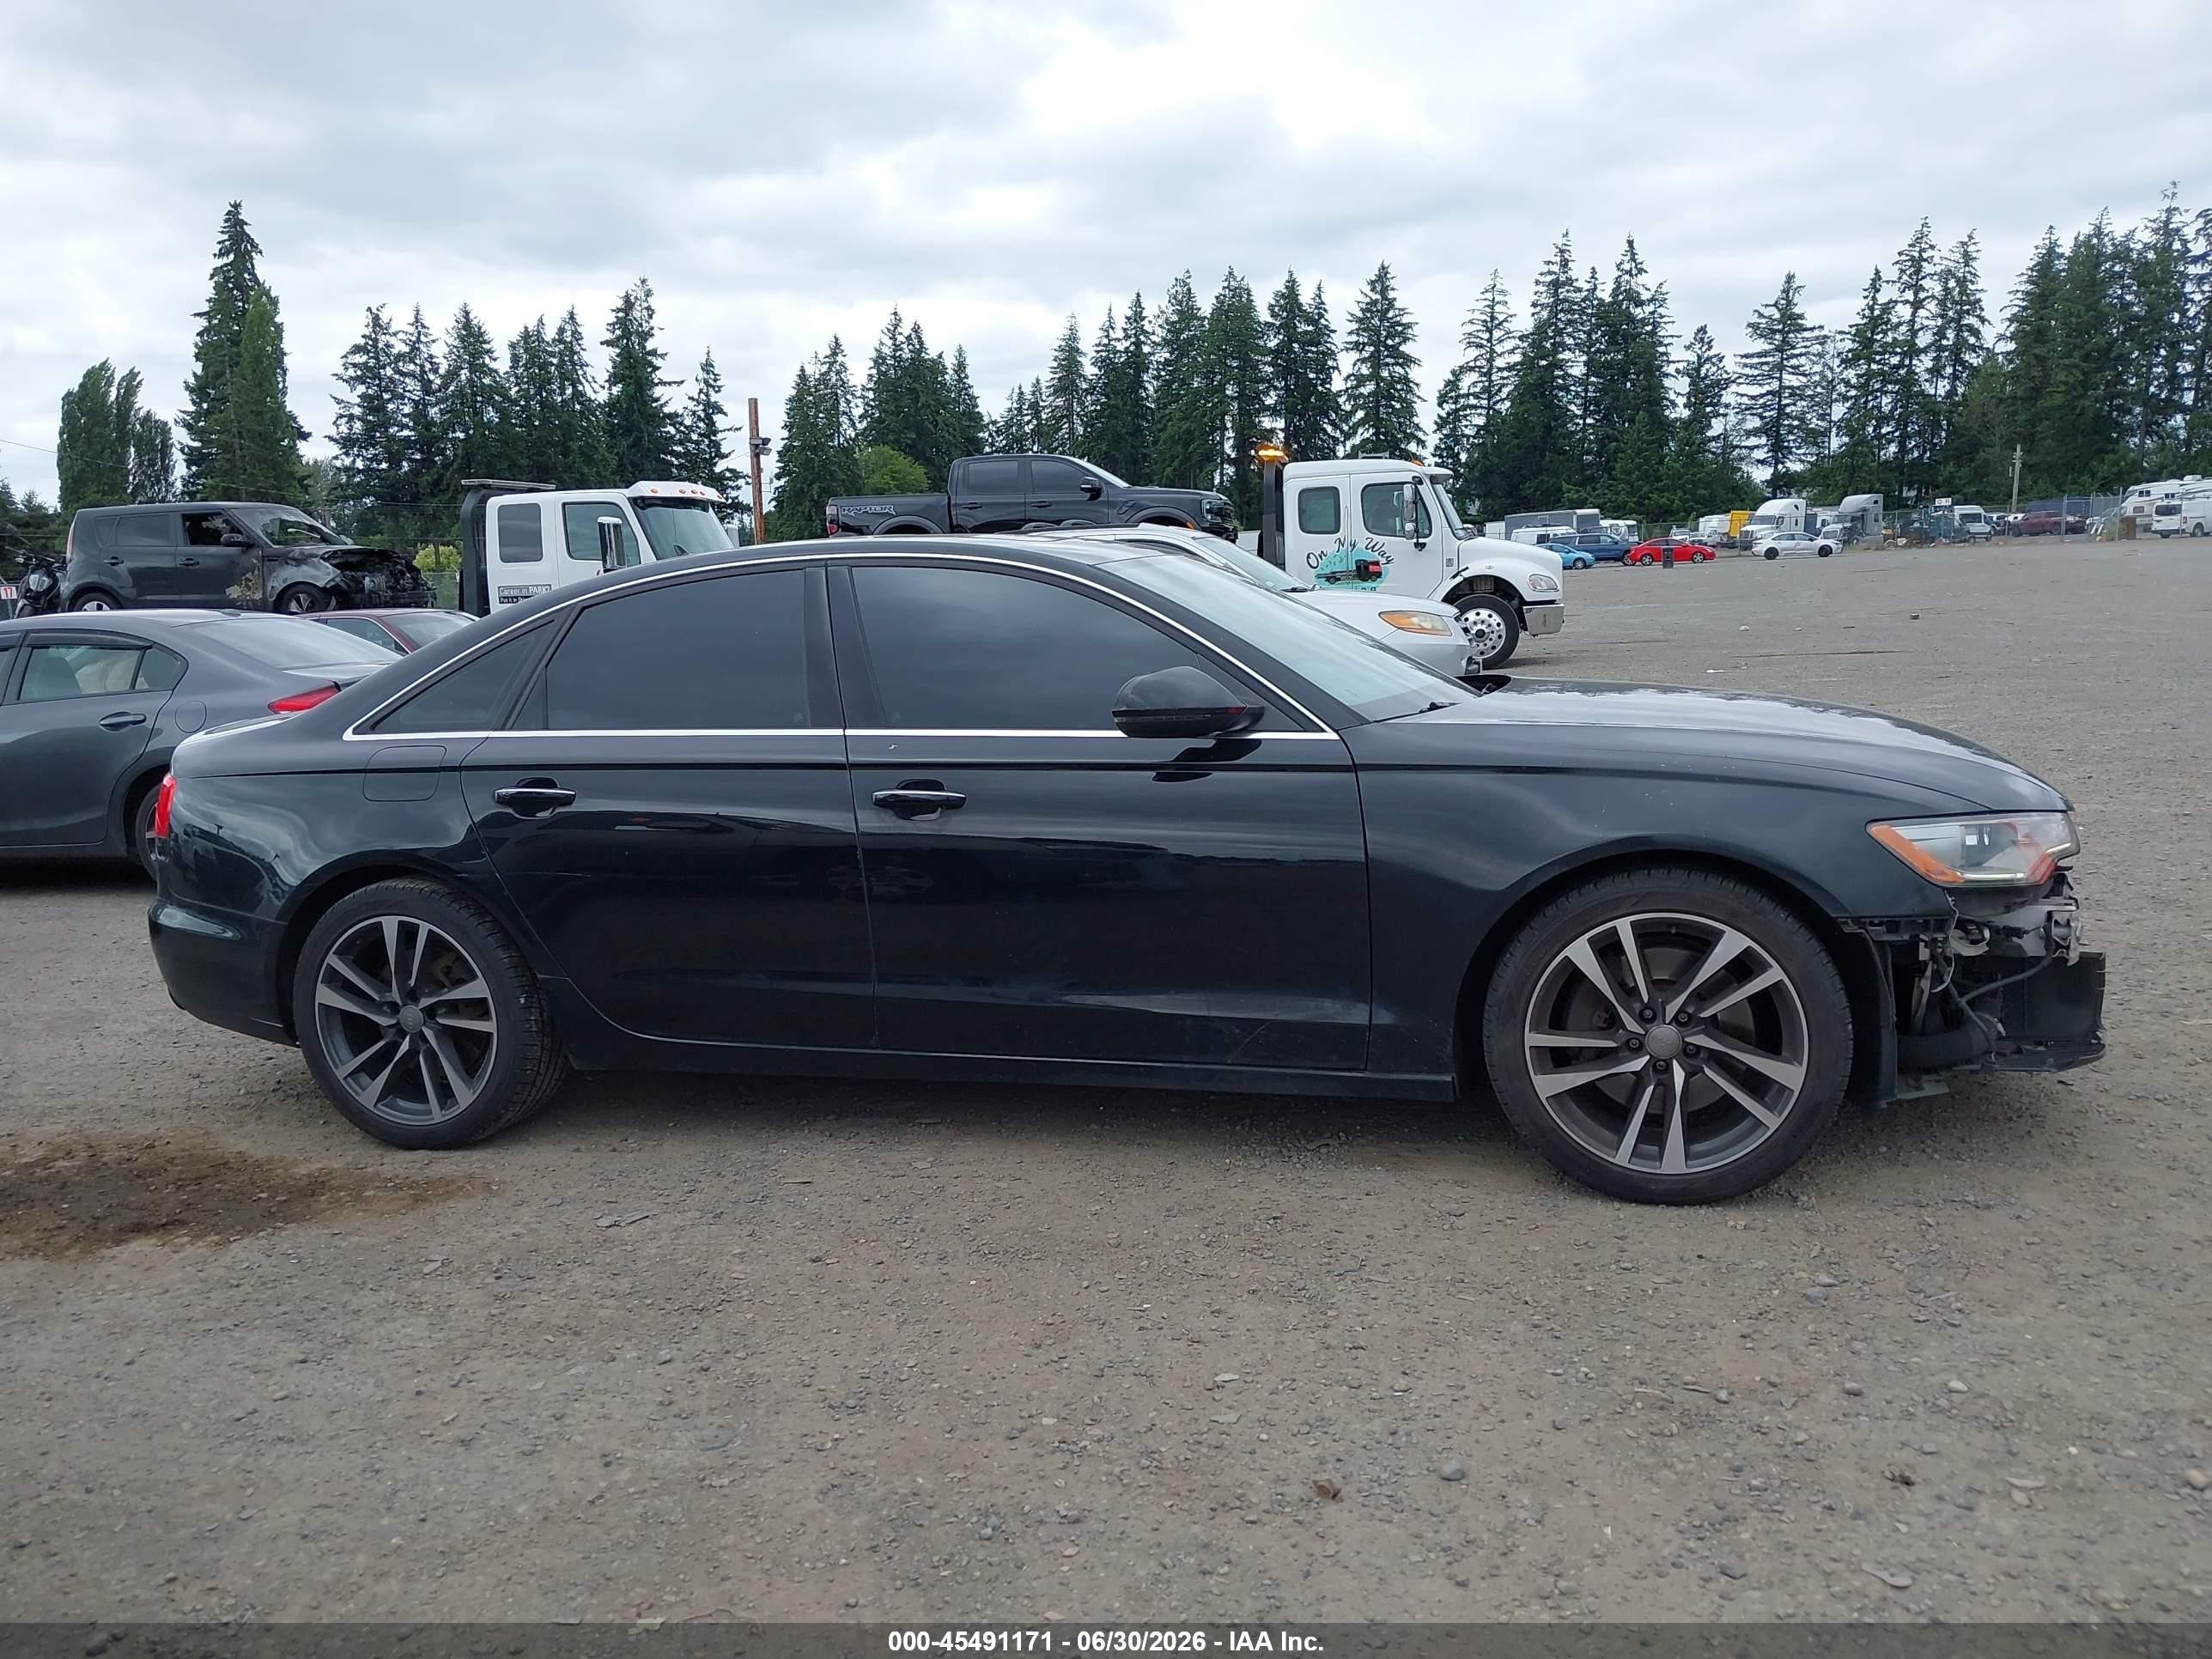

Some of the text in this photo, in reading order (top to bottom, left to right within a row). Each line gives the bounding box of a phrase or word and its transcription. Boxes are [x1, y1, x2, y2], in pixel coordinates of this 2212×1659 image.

[842, 505, 896, 516] RAPTOR
[1306, 550, 1328, 569] On
[1364, 537, 1395, 565] Way
[499, 586, 520, 595] Career
